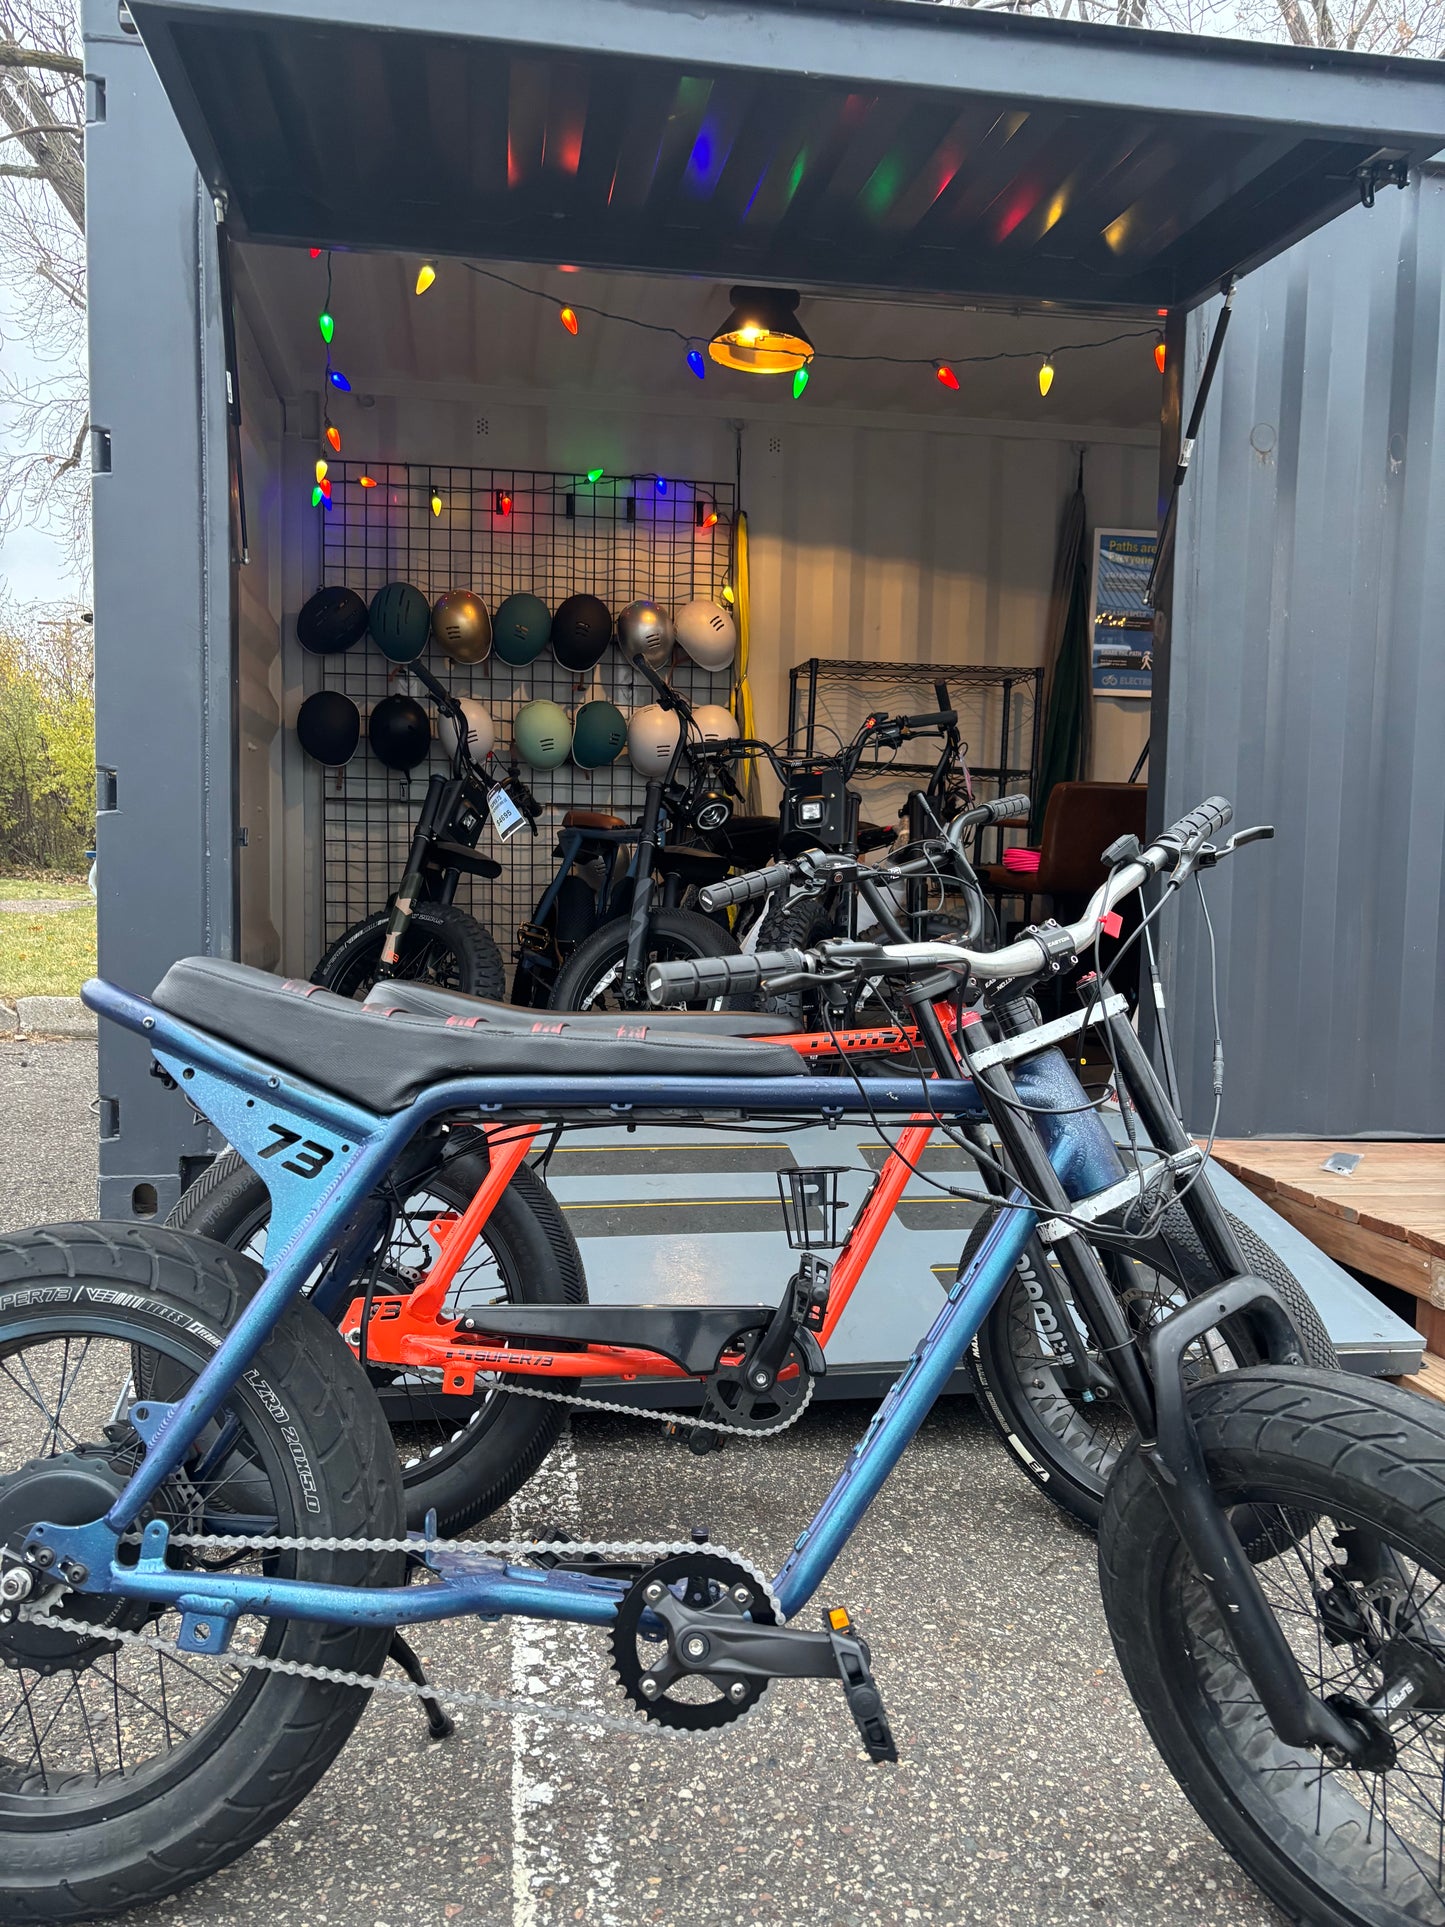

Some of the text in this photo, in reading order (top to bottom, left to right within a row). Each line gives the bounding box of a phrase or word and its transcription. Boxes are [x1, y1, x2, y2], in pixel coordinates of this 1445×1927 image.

[1109, 540, 1138, 552] Paths
[496, 810, 512, 826] $4695
[257, 1123, 334, 1179] 73
[474, 1351, 554, 1367] SUPER73
